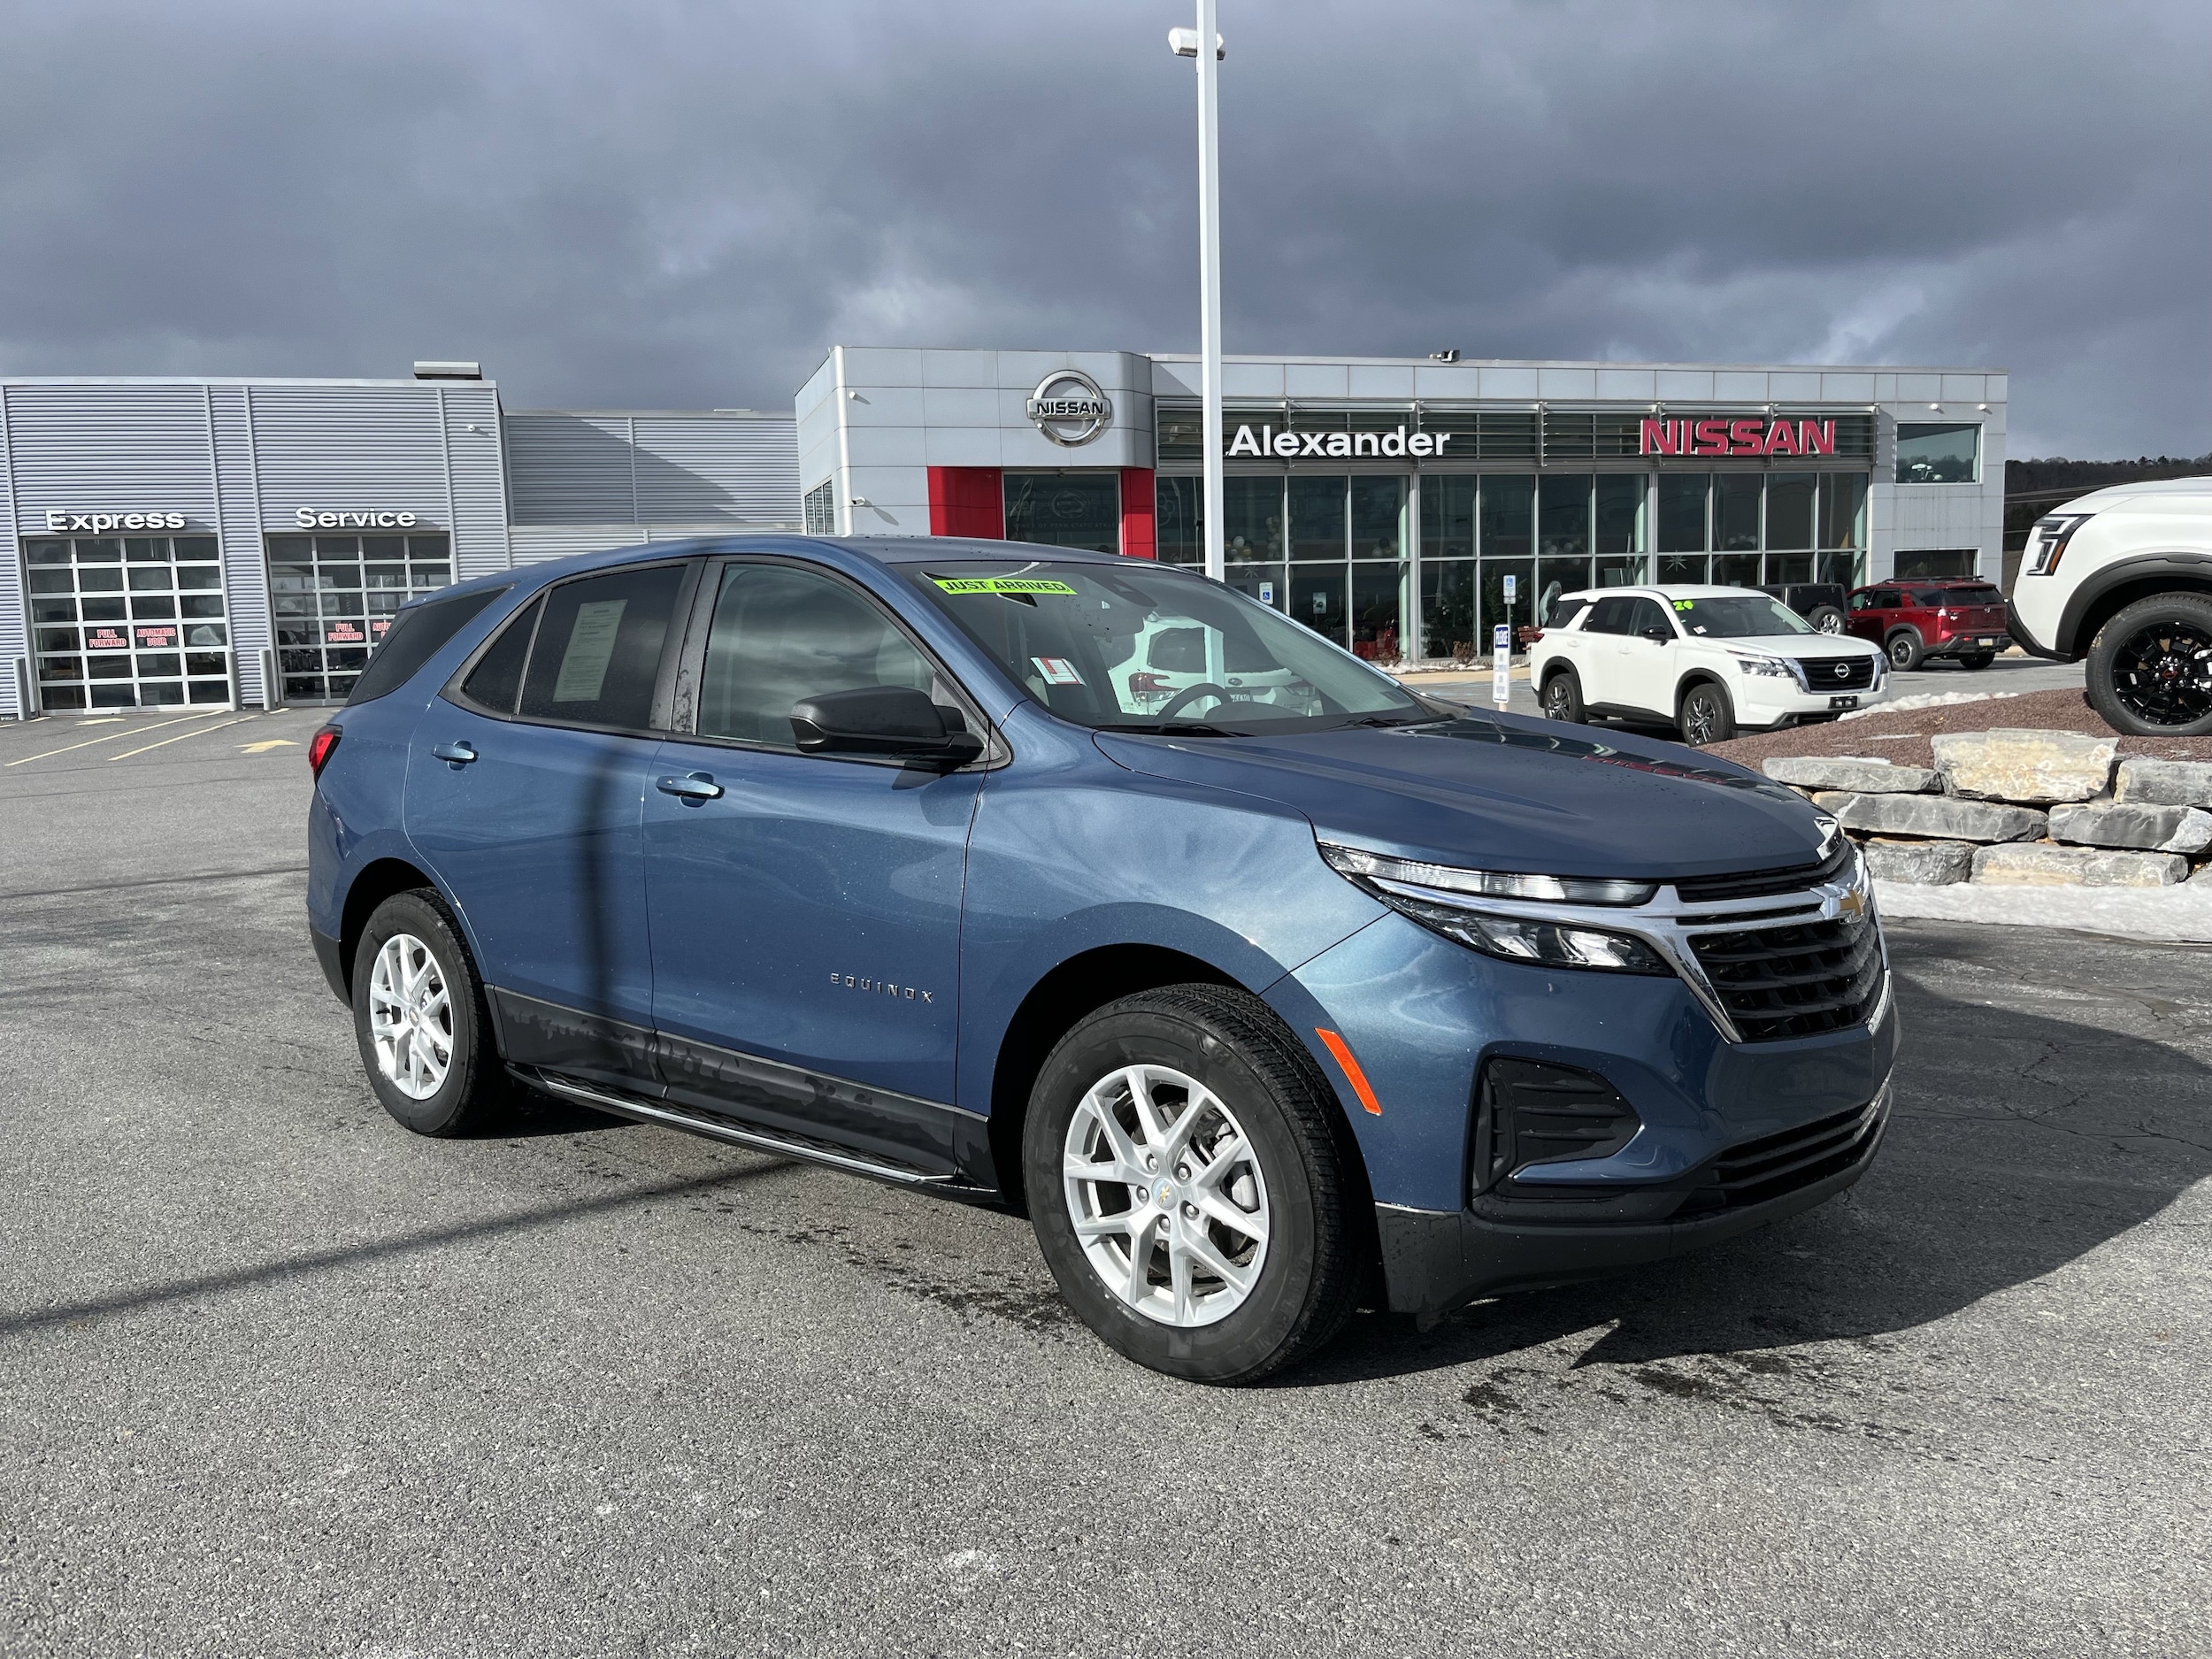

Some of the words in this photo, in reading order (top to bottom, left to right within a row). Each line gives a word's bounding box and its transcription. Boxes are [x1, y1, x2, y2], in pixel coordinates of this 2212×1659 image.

[1037, 401, 1103, 415] NISSAN
[1226, 425, 1451, 457] Alexander
[1639, 419, 1835, 455] NISSAN
[45, 510, 186, 535] Express
[295, 507, 417, 528] Service
[945, 580, 989, 592] JUST
[993, 580, 1070, 592] ARRIVED
[96, 629, 117, 638] PULL
[136, 627, 176, 637] AUTOMATIC
[335, 623, 355, 632] PULL
[146, 637, 168, 646] DOOR
[327, 632, 364, 641] FORWARD
[88, 638, 127, 648] FORWARD
[831, 972, 933, 1004] EQUINOX
